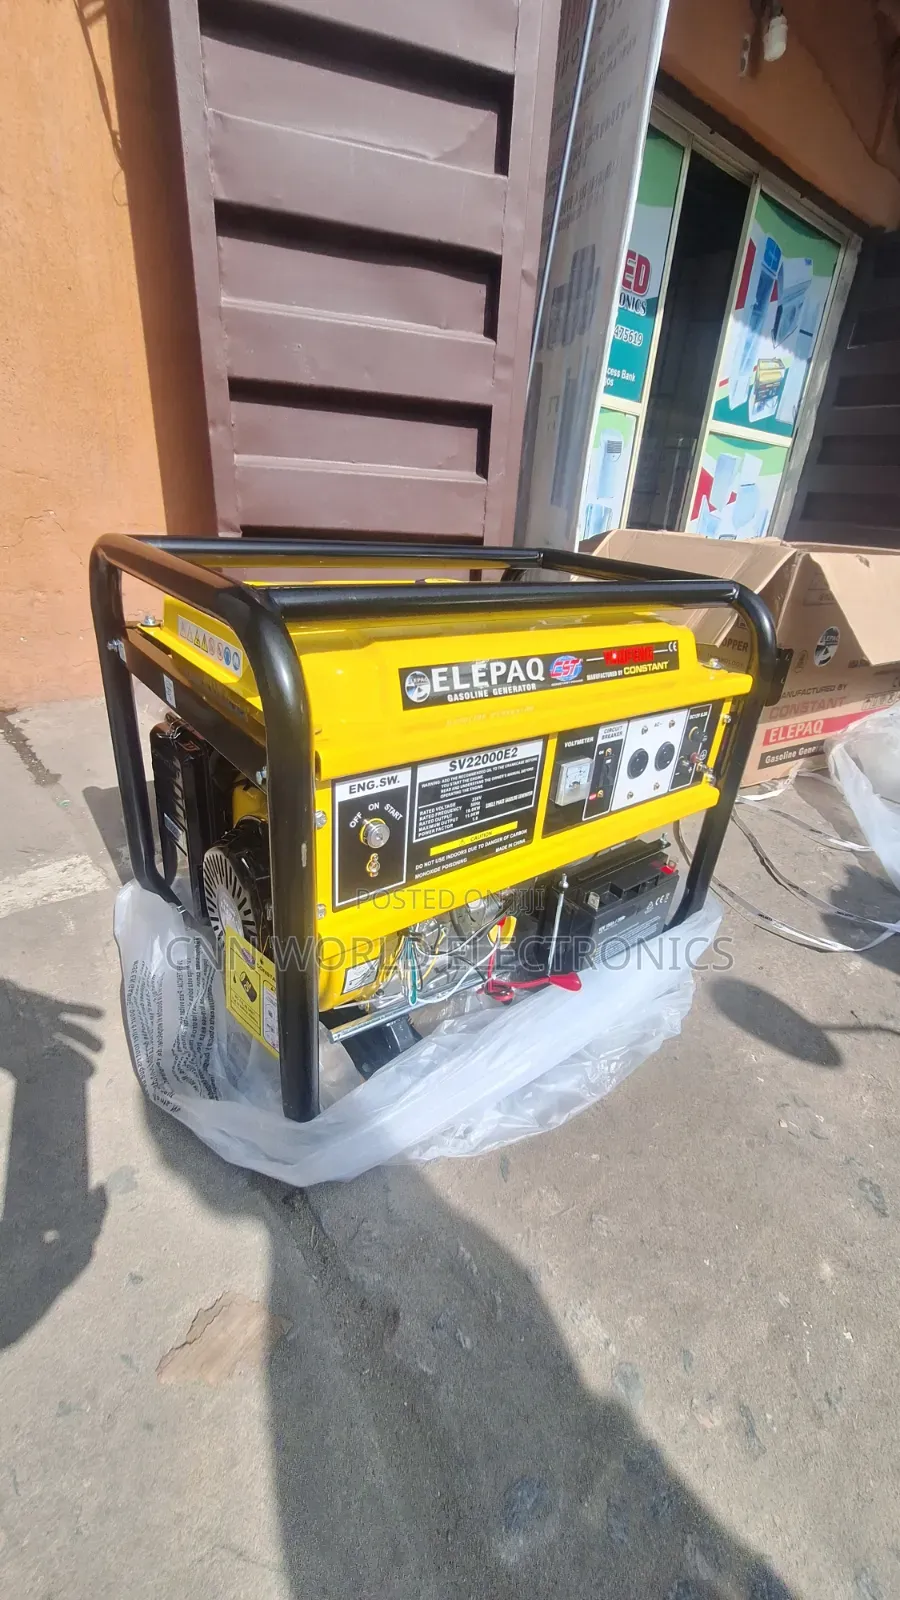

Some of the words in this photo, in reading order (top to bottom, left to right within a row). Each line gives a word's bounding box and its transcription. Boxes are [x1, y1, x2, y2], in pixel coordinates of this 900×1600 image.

[620, 292, 646, 316] ONICS
[621, 369, 636, 382] Bank
[431, 656, 546, 692] ELEPAQ
[586, 671, 618, 681] MANUFACTURED
[624, 661, 669, 675] CONSTANT
[448, 690, 489, 702] GASOLINE
[492, 683, 536, 696] GENERATOR
[768, 697, 847, 720] CONSTANT
[602, 731, 623, 740] BREAKER
[604, 726, 623, 734] CIRCUIT
[769, 720, 824, 742] ELEPAQ
[564, 736, 594, 748] VOLTMETER
[449, 747, 518, 772] SV22000E2
[765, 750, 796, 764] Gasoline
[349, 775, 400, 794] ENG.SW.
[440, 790, 461, 798] OPERATING
[368, 802, 380, 811] ON
[384, 804, 403, 821] START
[435, 806, 462, 817] FREQUENCY
[436, 802, 456, 810] VOLTAGE
[350, 812, 363, 828] OFF
[419, 823, 440, 832] MAXIMUM
[441, 817, 459, 826] OUTPUT
[434, 813, 452, 822] OUTPUT
[418, 829, 435, 837] POWER
[436, 823, 454, 832] FACTOR
[470, 831, 493, 842] CAUTION
[446, 850, 468, 861] INDOORS
[485, 838, 503, 848] DANGER
[510, 829, 528, 839] CARBON
[496, 844, 508, 853] MADE
[514, 839, 526, 847] CHINA
[414, 866, 441, 880] MONOXIDE
[441, 858, 467, 870] POISONING
